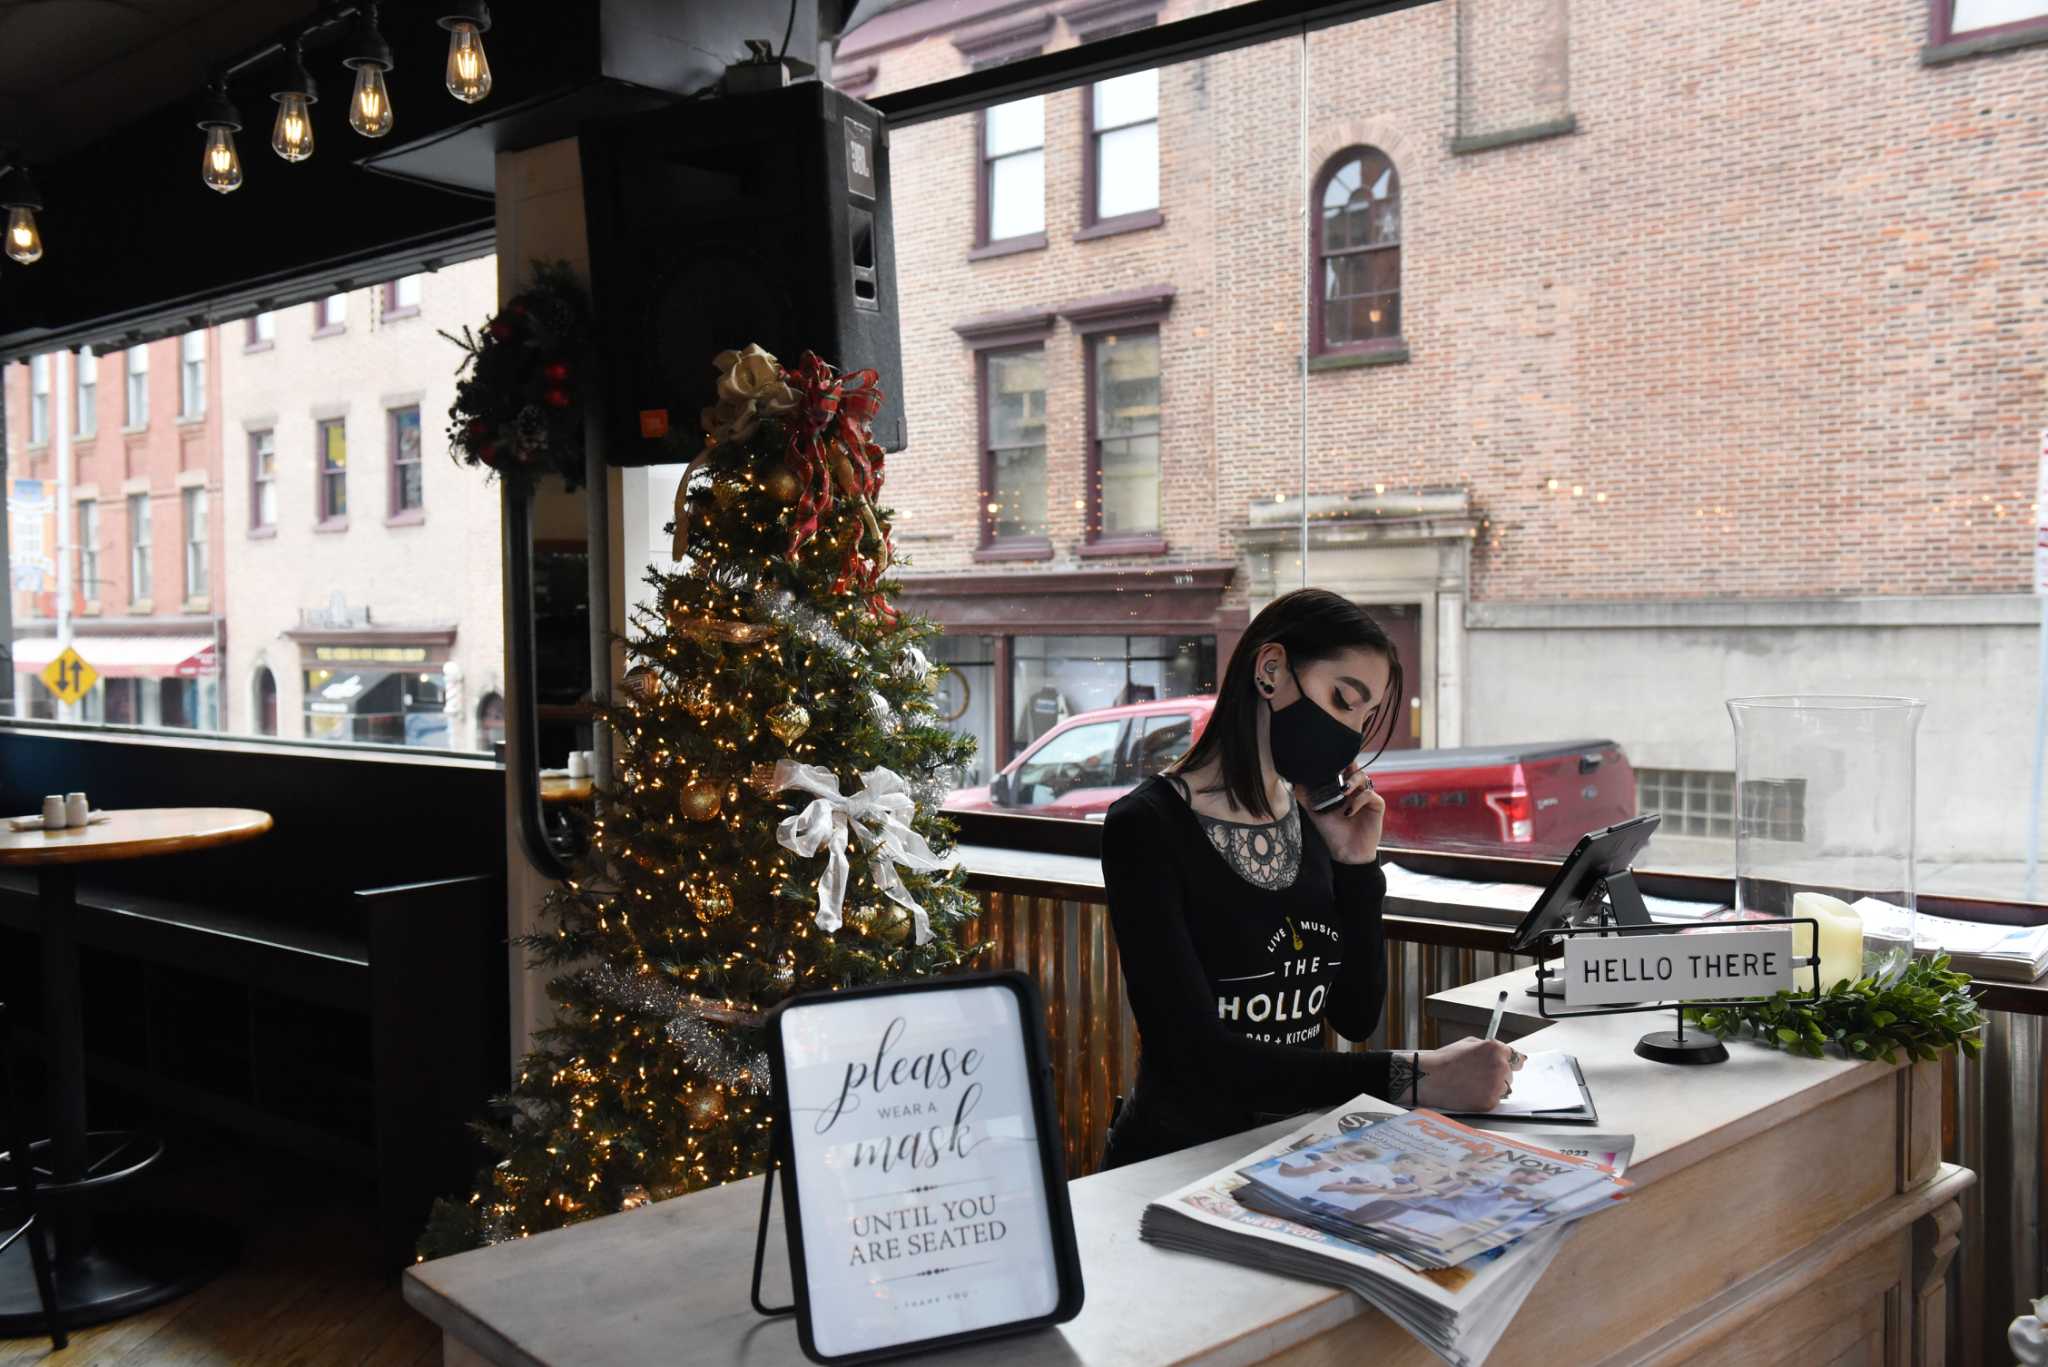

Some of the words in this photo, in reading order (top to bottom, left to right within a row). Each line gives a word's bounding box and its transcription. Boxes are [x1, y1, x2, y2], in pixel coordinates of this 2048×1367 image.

[1266, 928, 1288, 953] LIVE
[1300, 920, 1340, 942] MUSIC
[1283, 956, 1321, 978] THE
[1583, 956, 1674, 984] HELLO
[1687, 951, 1778, 980] THERE
[1218, 982, 1332, 1022] HOLLO
[1286, 1023, 1321, 1045] KITCHEN
[814, 1016, 984, 1134] please
[852, 1081, 990, 1174] mask
[876, 1104, 924, 1120] WEAR
[926, 1101, 939, 1114] A
[852, 1205, 938, 1238] UNTIL
[942, 1194, 997, 1223] YOU
[849, 1237, 902, 1267] ARE
[907, 1220, 1008, 1257] SEATED
